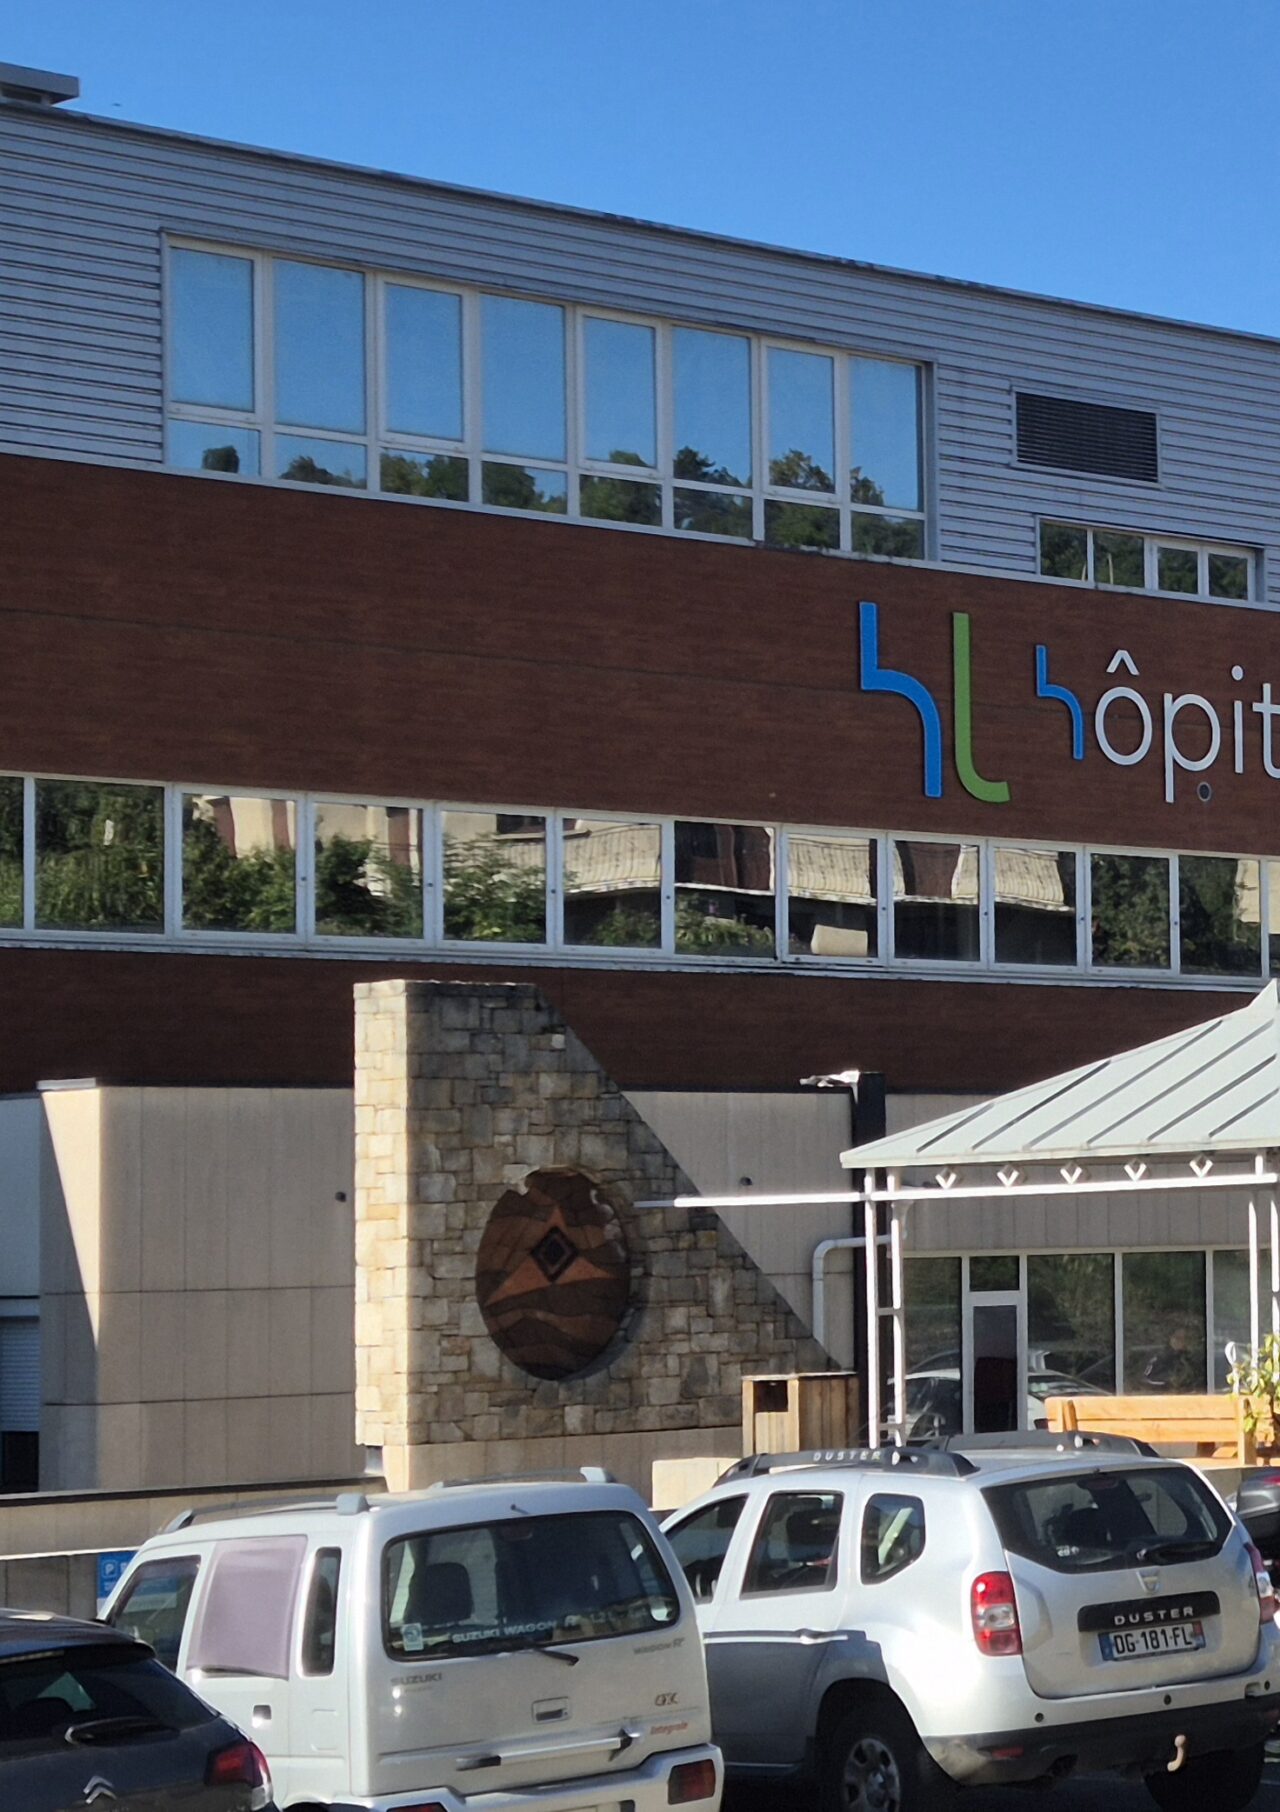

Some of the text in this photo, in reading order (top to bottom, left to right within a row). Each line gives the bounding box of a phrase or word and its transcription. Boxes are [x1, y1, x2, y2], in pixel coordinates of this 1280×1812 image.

[813, 1451, 881, 1462] DUSTER
[1114, 1606, 1194, 1626] DUSTER
[452, 1628, 501, 1643] SUZUKI
[1113, 1626, 1193, 1655] DG-181-FL
[390, 1672, 443, 1687] SUZUKI
